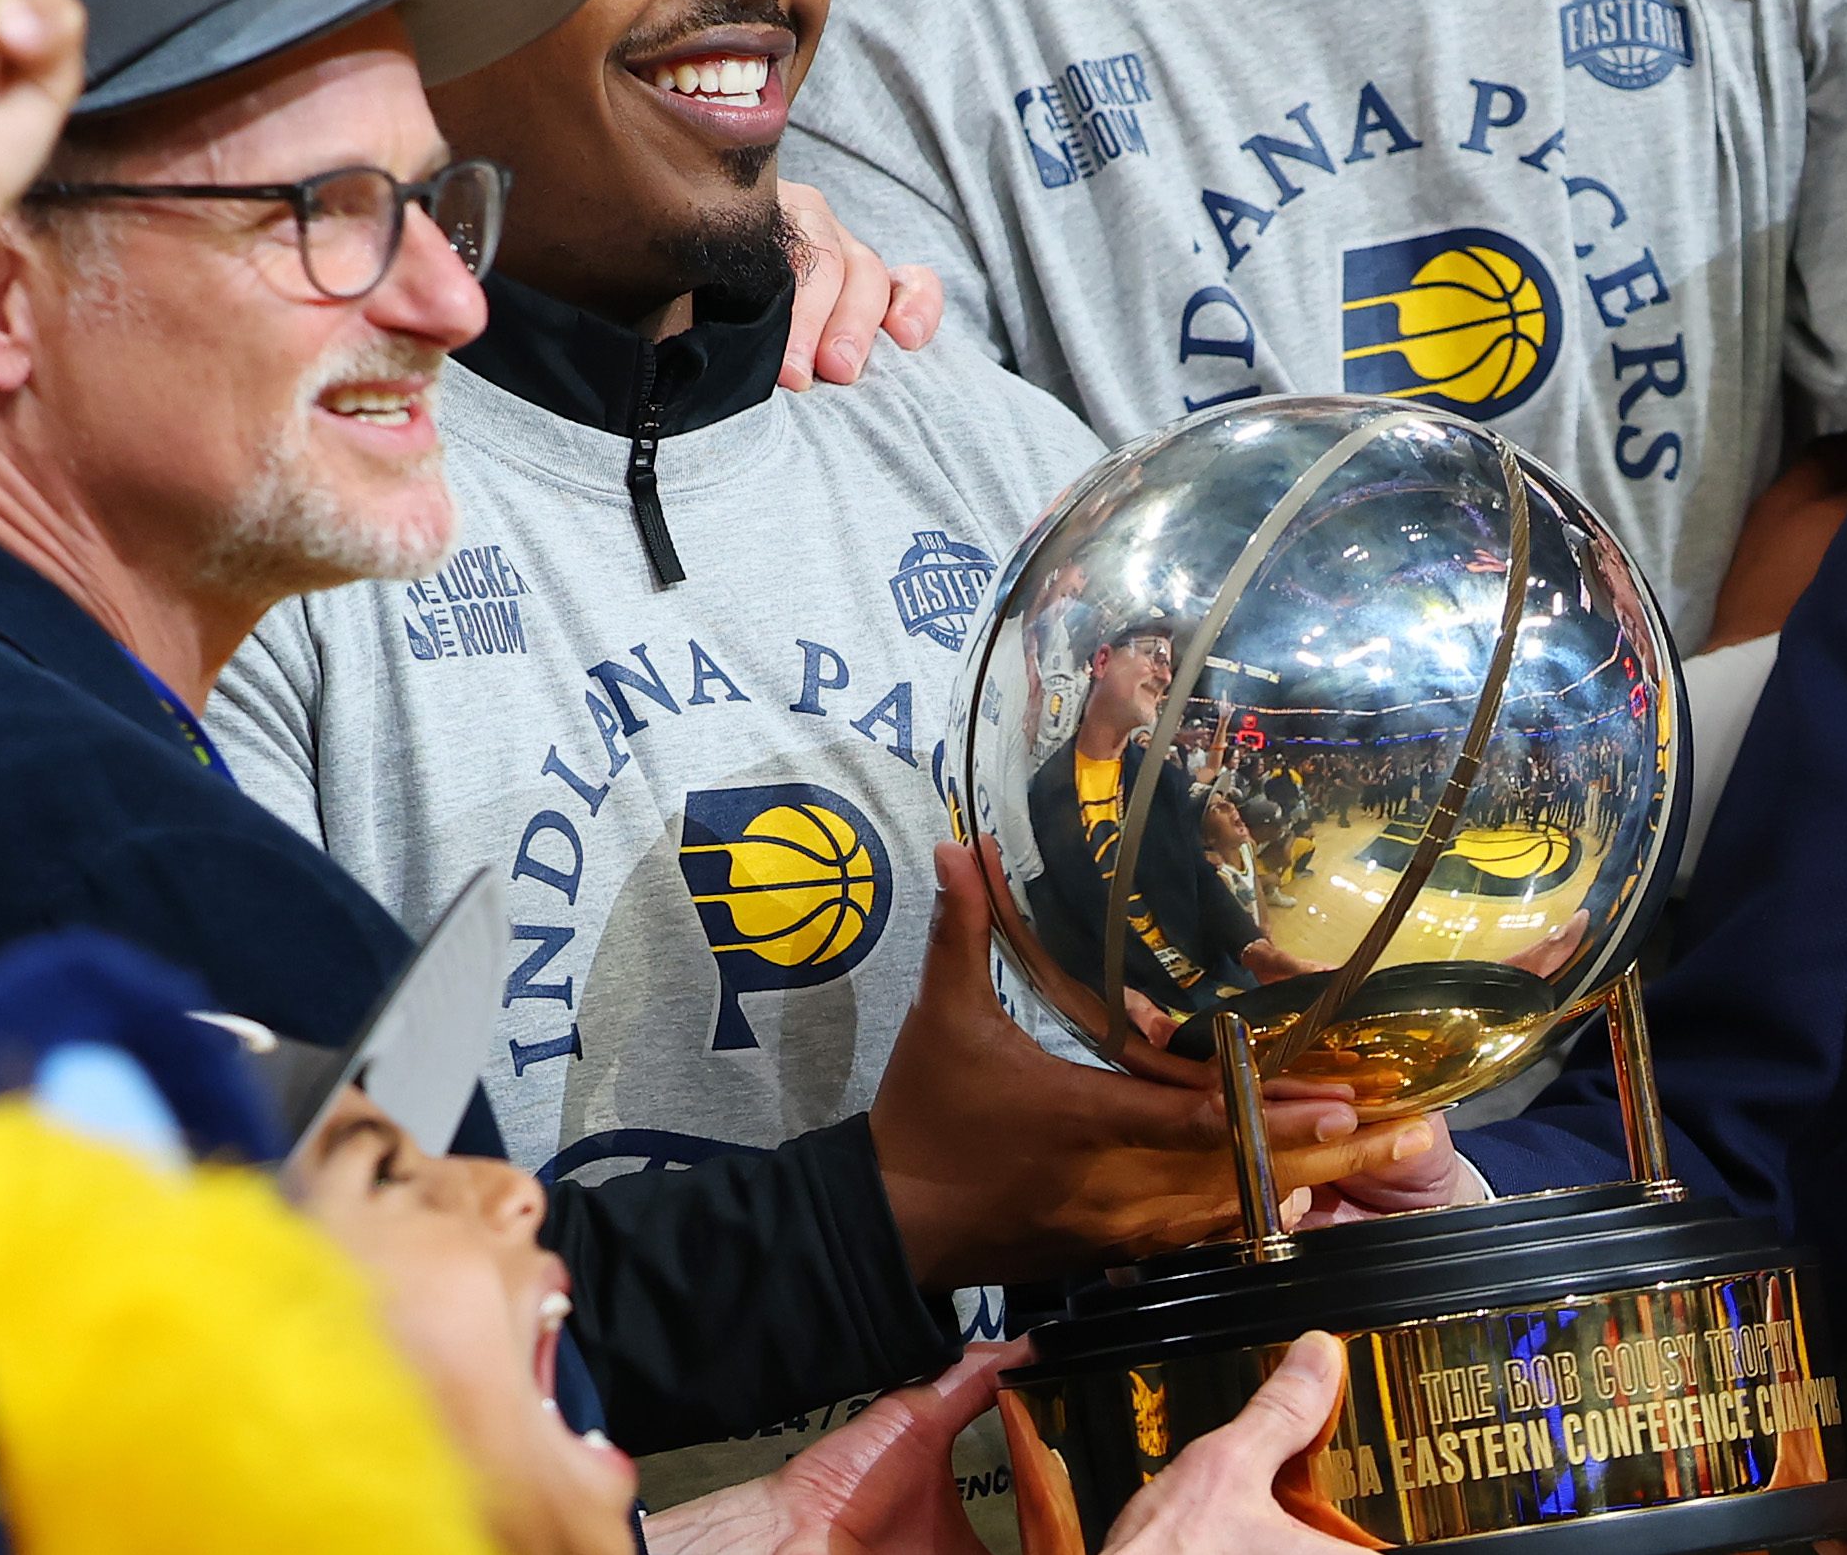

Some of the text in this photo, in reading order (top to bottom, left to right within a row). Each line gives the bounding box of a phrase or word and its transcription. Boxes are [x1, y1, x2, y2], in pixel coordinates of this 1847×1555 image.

[916, 532, 947, 550] NBA
[451, 599, 528, 658] ROOM
[897, 568, 996, 622] EASTER
[501, 638, 752, 1078] INDIANA
[1419, 1319, 1798, 1425] THE BOB COUSY TROPHY
[1390, 1417, 1555, 1491] EASTERN
[1562, 1387, 1754, 1466] CONFERENCE
